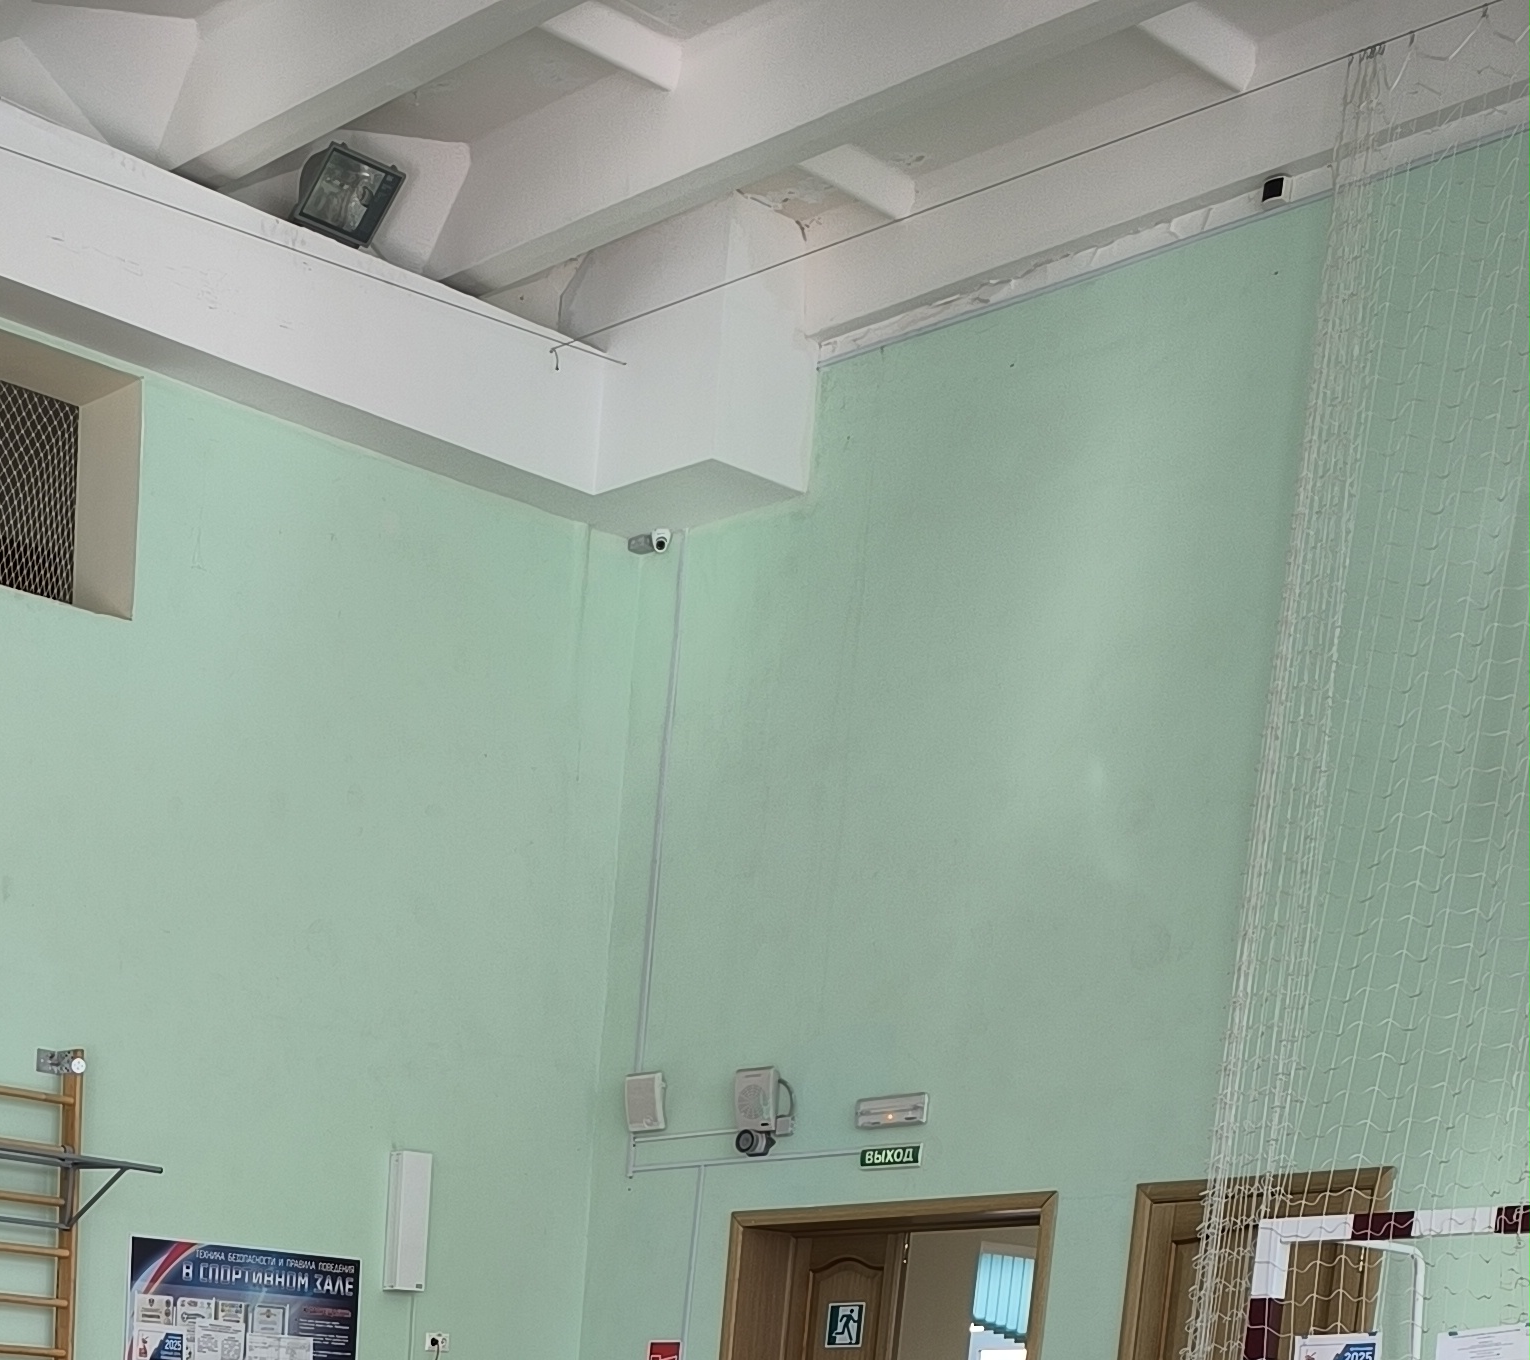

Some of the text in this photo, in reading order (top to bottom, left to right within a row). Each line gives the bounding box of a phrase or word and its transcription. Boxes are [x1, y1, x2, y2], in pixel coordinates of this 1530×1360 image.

[865, 1148, 914, 1164] ВЫХОД
[195, 1249, 355, 1274] ТЕХНИКА БЕЗОПАСНОСТИ И ПРАВИЛА ПОВЕДЕНИЯ
[182, 1261, 354, 1297] В СПОРТИВНОМ ЗАЛЕ
[165, 1340, 182, 1350] 2025
